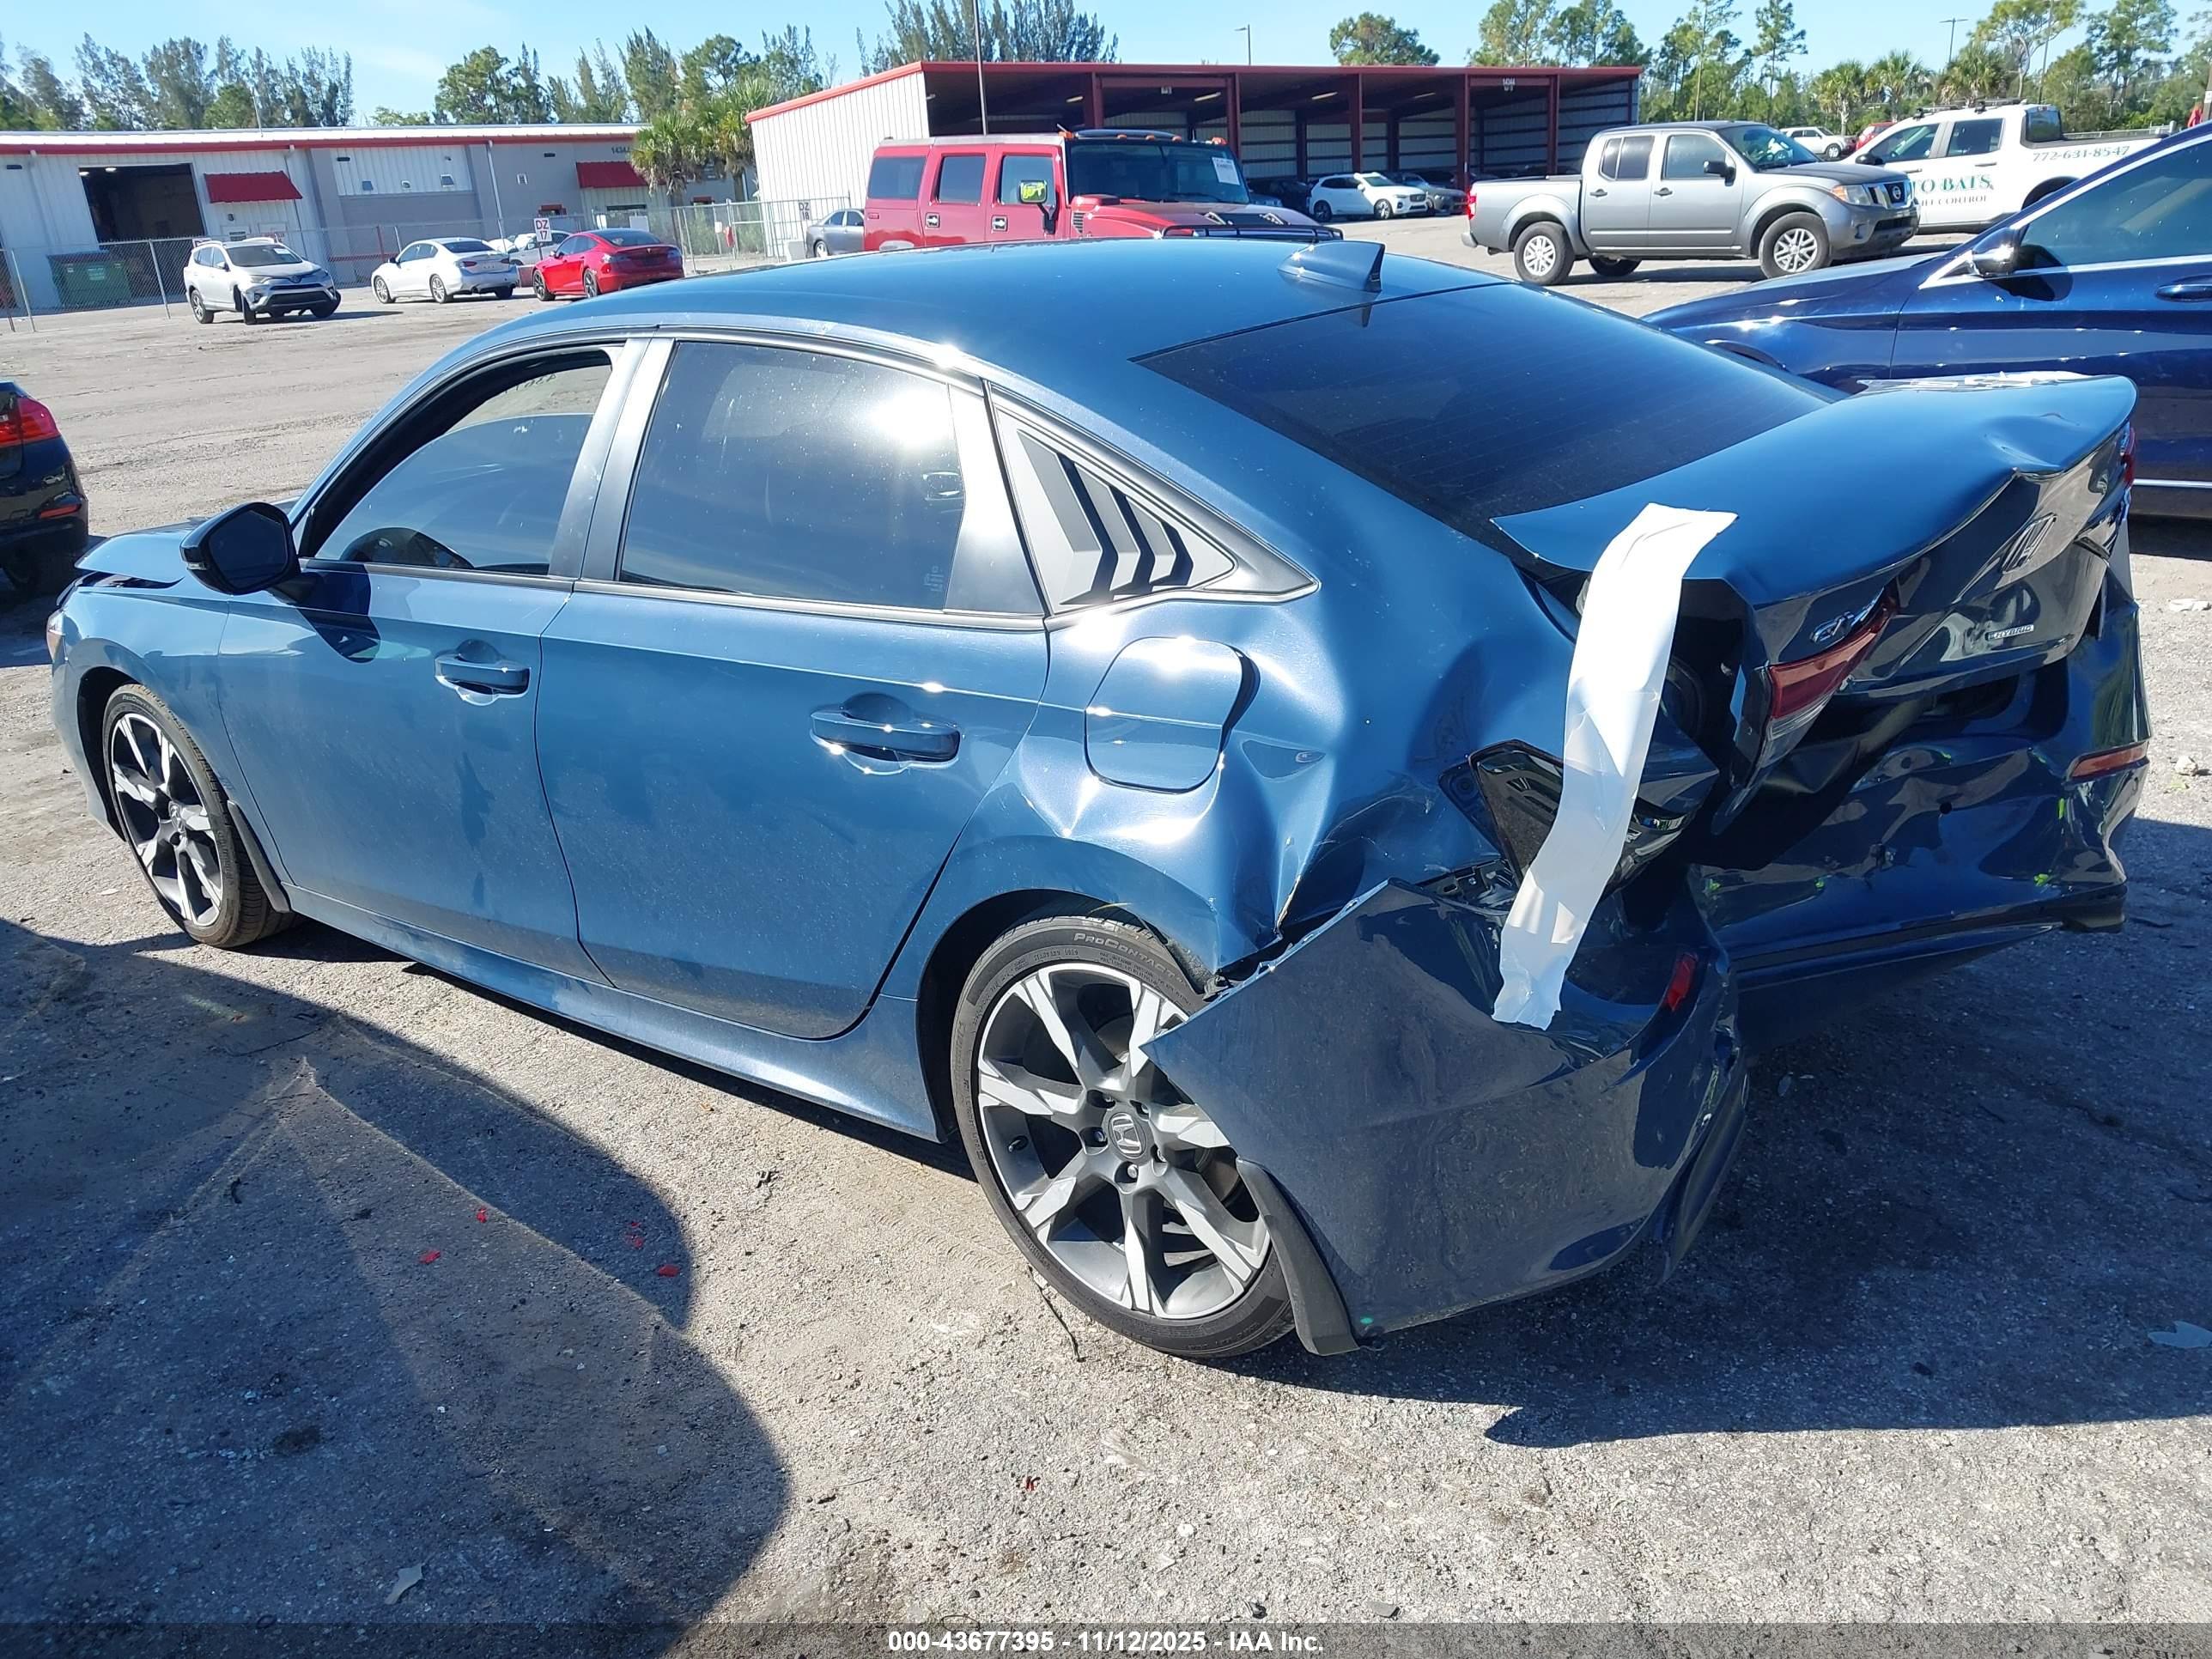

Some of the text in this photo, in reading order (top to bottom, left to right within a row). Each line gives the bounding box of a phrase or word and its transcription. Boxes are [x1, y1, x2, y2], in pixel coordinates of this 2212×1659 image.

[799, 202, 810, 211] DZ
[535, 219, 550, 230] DZ
[539, 230, 548, 240] 17
